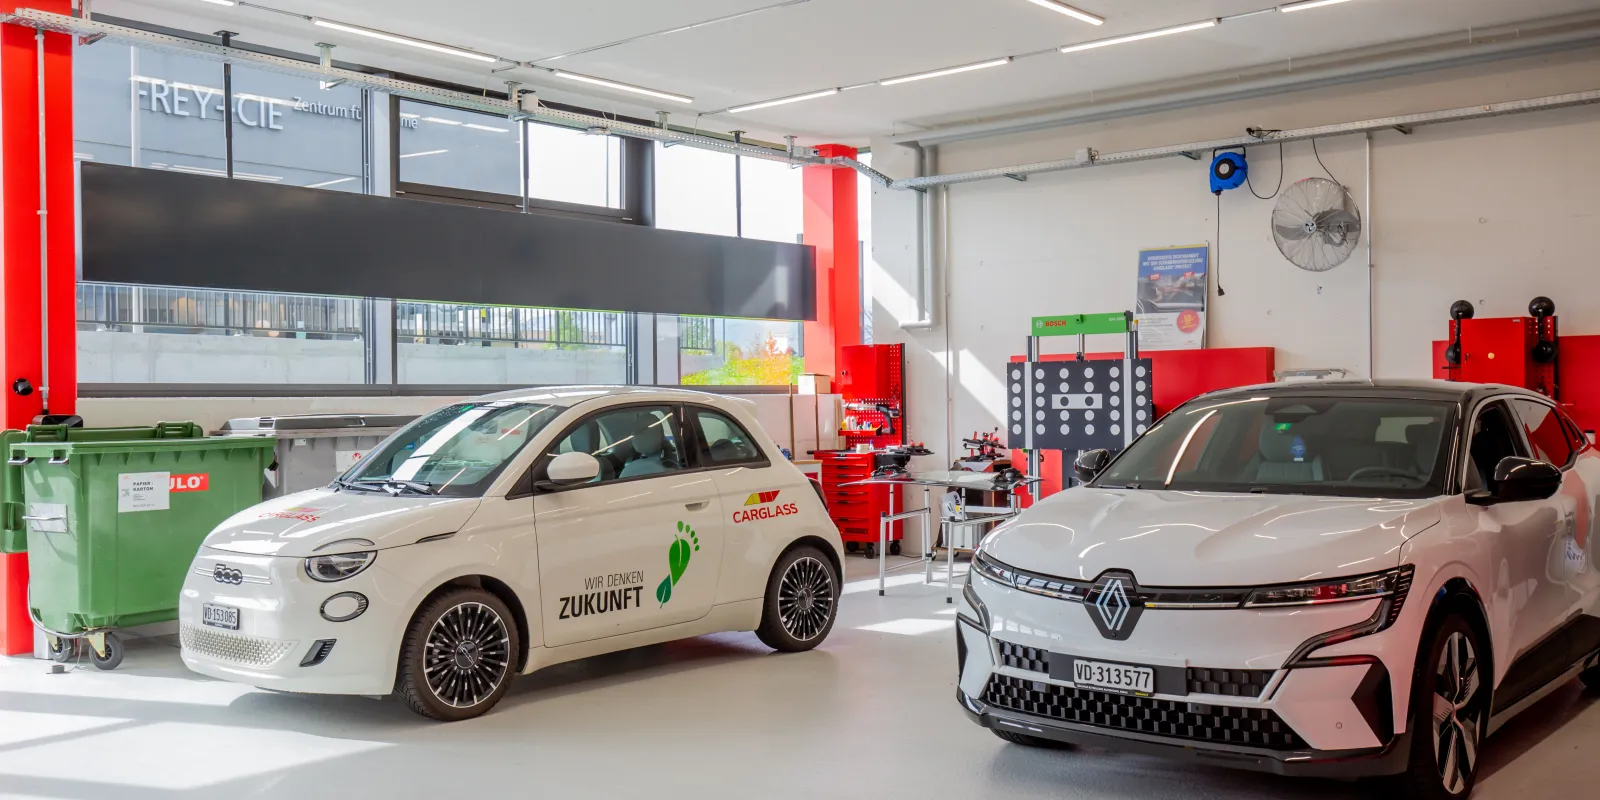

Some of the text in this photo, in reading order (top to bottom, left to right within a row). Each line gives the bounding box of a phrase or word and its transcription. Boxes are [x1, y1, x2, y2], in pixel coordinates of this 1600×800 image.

[293, 96, 362, 120] Zentrum fü
[1045, 319, 1066, 327] BOSCH
[732, 502, 799, 524] CARGLASS
[213, 563, 243, 585] 500
[584, 570, 644, 590] WIR DENKEN
[559, 585, 644, 620] ZUKUNFT
